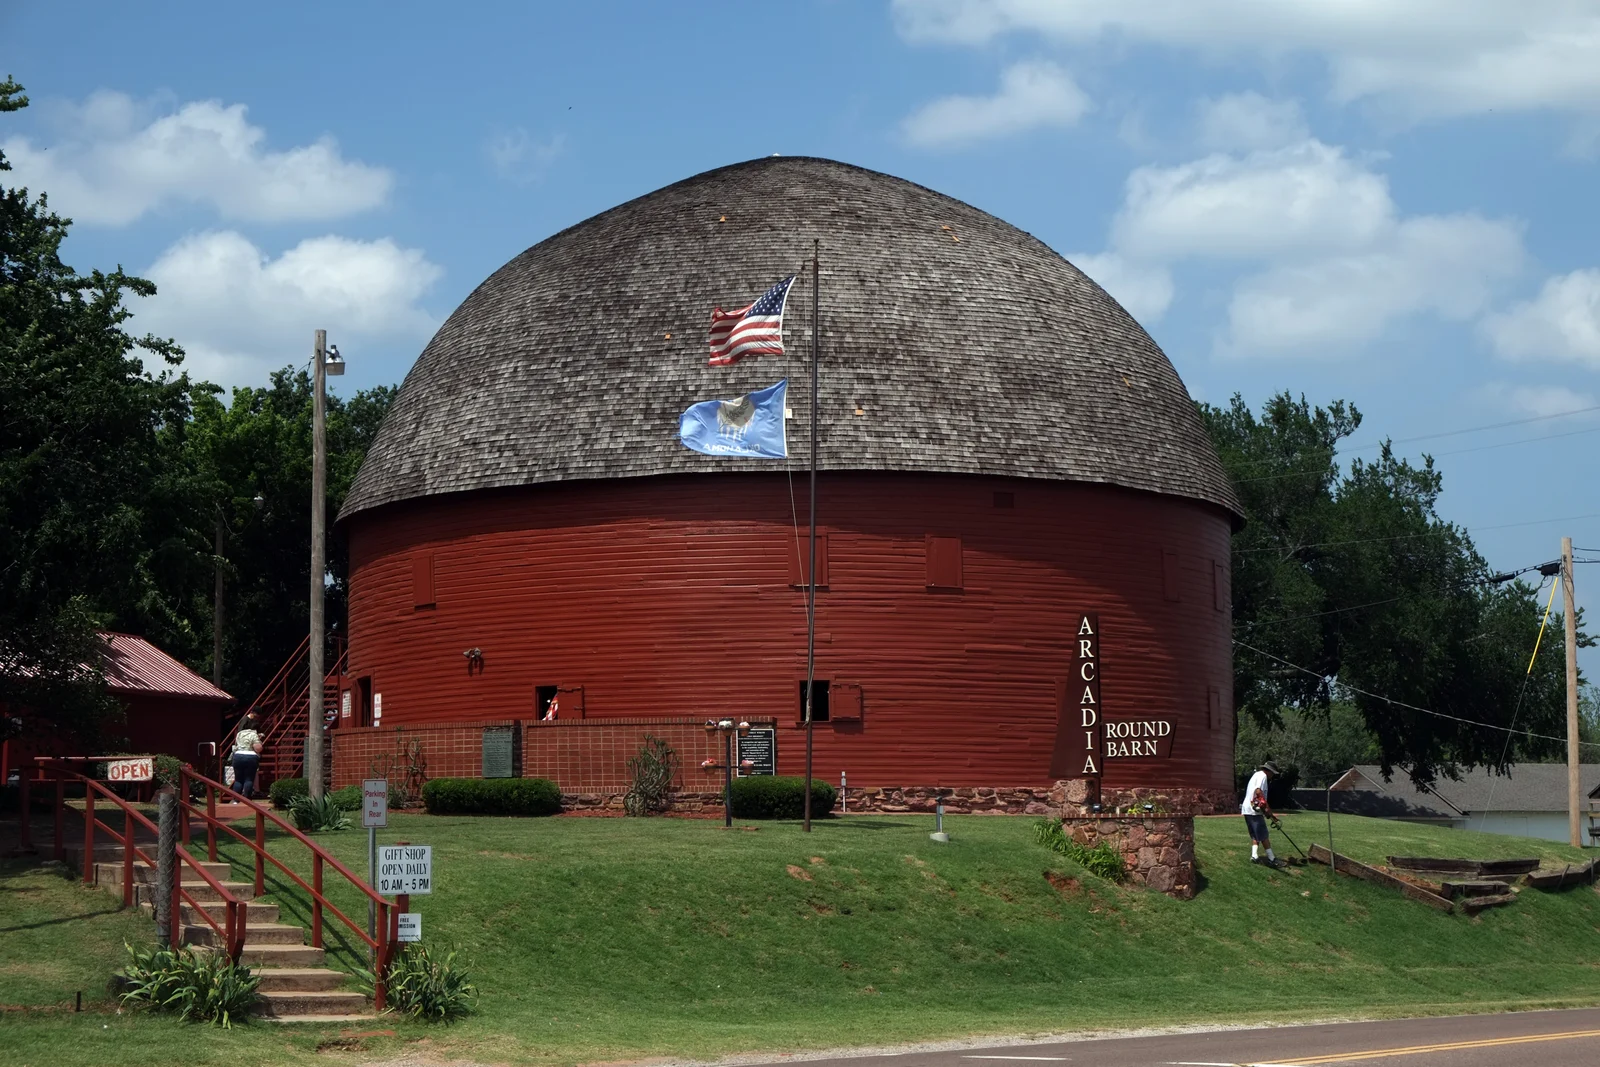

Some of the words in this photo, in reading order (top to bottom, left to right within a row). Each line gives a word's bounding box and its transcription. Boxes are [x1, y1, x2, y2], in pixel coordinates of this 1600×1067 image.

[1078, 616, 1098, 774] ARCADIA
[1105, 720, 1171, 739] ROUND
[1106, 740, 1158, 758] BARN
[111, 763, 149, 780] OPEN
[365, 790, 386, 798] Parking
[368, 810, 382, 818] Rear
[384, 848, 403, 861] GIFT
[404, 848, 426, 860] SHOP
[381, 863, 404, 876] OPEN
[406, 863, 428, 875] DAILY
[380, 879, 389, 891] 10
[391, 879, 403, 891] AM
[411, 878, 417, 890] 5
[418, 878, 430, 890] PM
